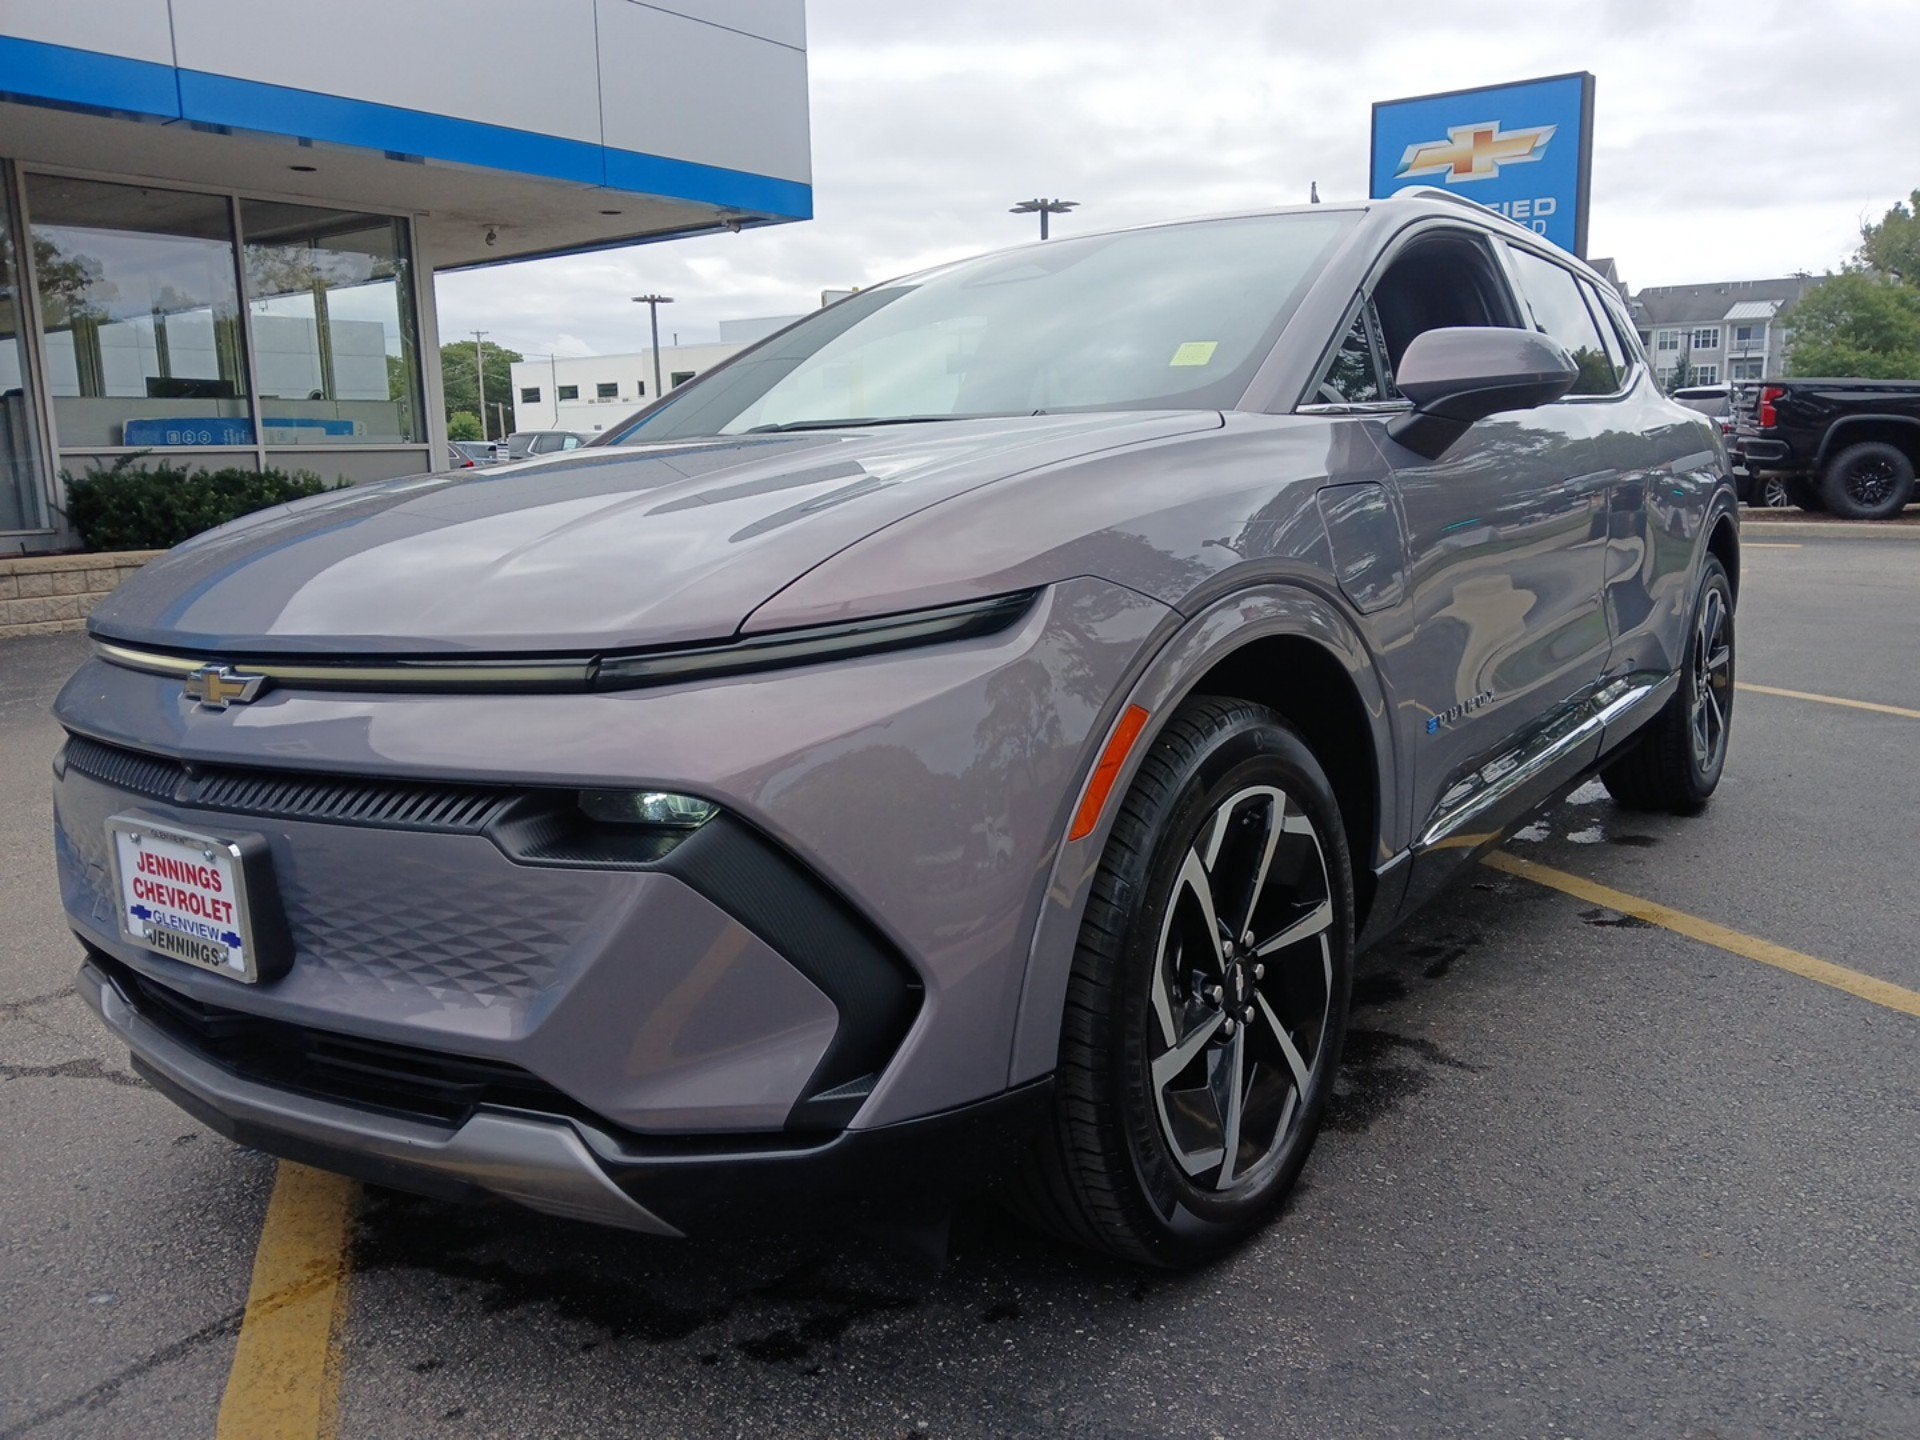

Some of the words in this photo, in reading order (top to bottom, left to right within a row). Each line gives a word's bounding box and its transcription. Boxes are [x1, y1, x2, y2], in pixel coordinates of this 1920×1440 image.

[137, 851, 222, 893] JENNINGS
[133, 877, 233, 924] CHEVROLET
[153, 910, 219, 940] GLENVIEW
[150, 929, 220, 967] JENNINGS
